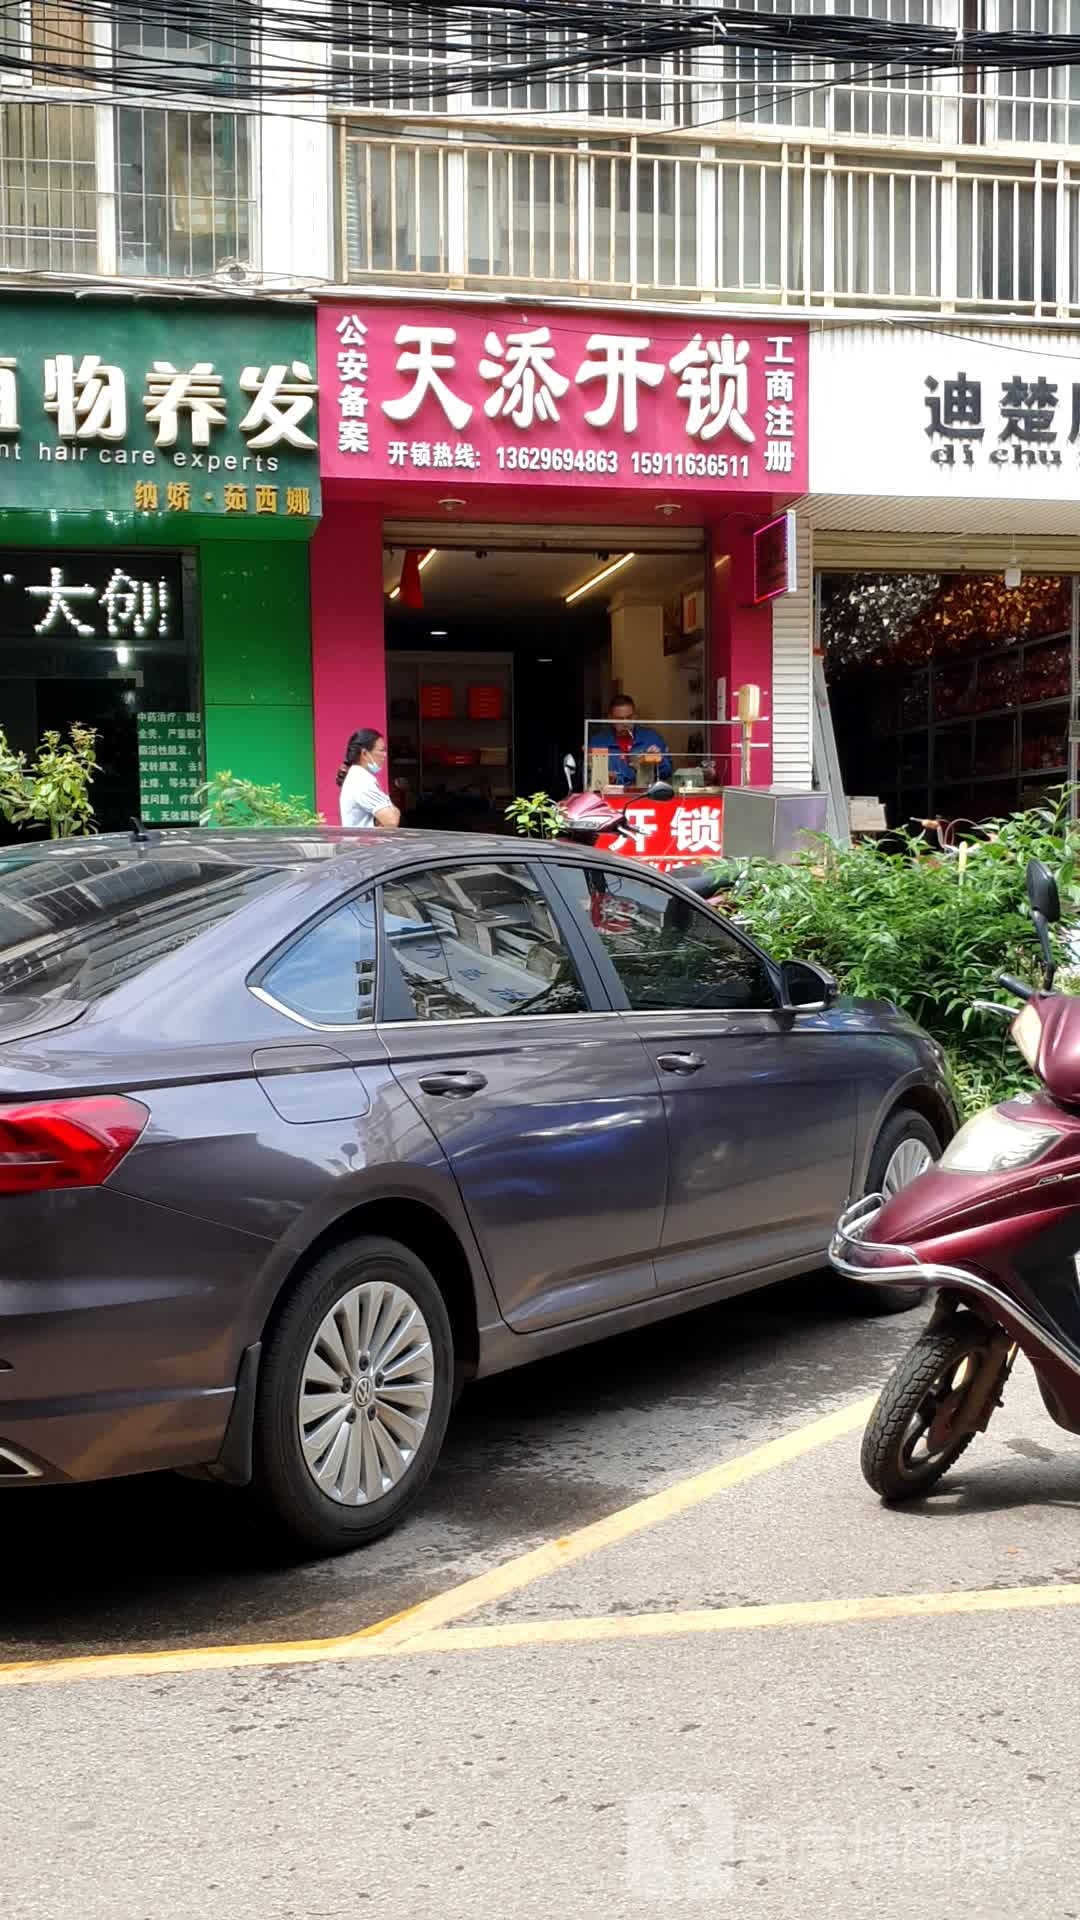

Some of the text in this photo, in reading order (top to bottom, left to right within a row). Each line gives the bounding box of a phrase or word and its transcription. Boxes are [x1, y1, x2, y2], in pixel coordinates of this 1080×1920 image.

[336, 314, 369, 453] 公安备案
[381, 324, 756, 443] 天添开锁
[764, 336, 795, 472] 工商注册
[39, 442, 88, 461] hair
[99, 447, 156, 465] care
[174, 452, 279, 473] experts
[387, 441, 749, 477] 开锁热线: 13629694863 15911636511
[608, 806, 721, 852] 开锁
